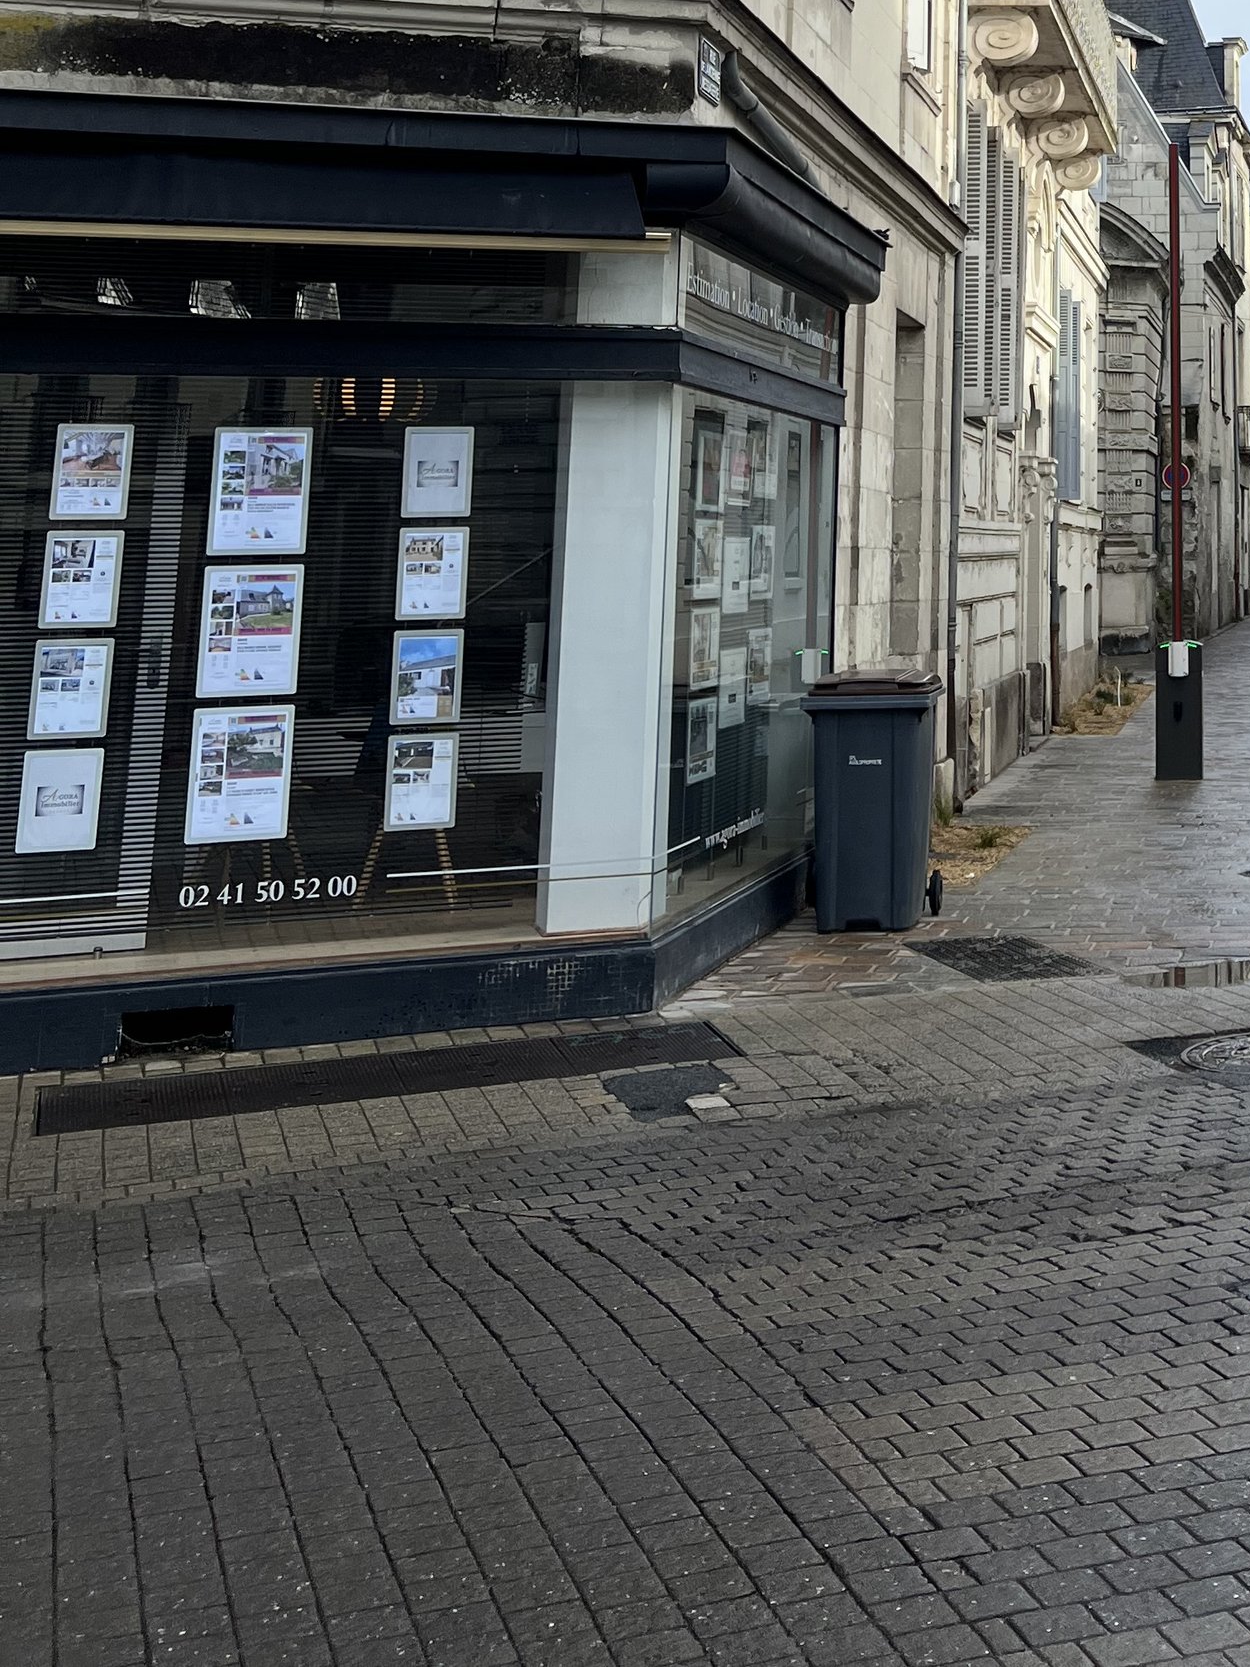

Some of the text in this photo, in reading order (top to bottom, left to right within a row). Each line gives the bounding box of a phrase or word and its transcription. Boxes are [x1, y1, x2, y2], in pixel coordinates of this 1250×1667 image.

[686, 261, 730, 310] Estimation
[737, 286, 769, 326] Location
[178, 875, 357, 908] 02 41 50 52 00
